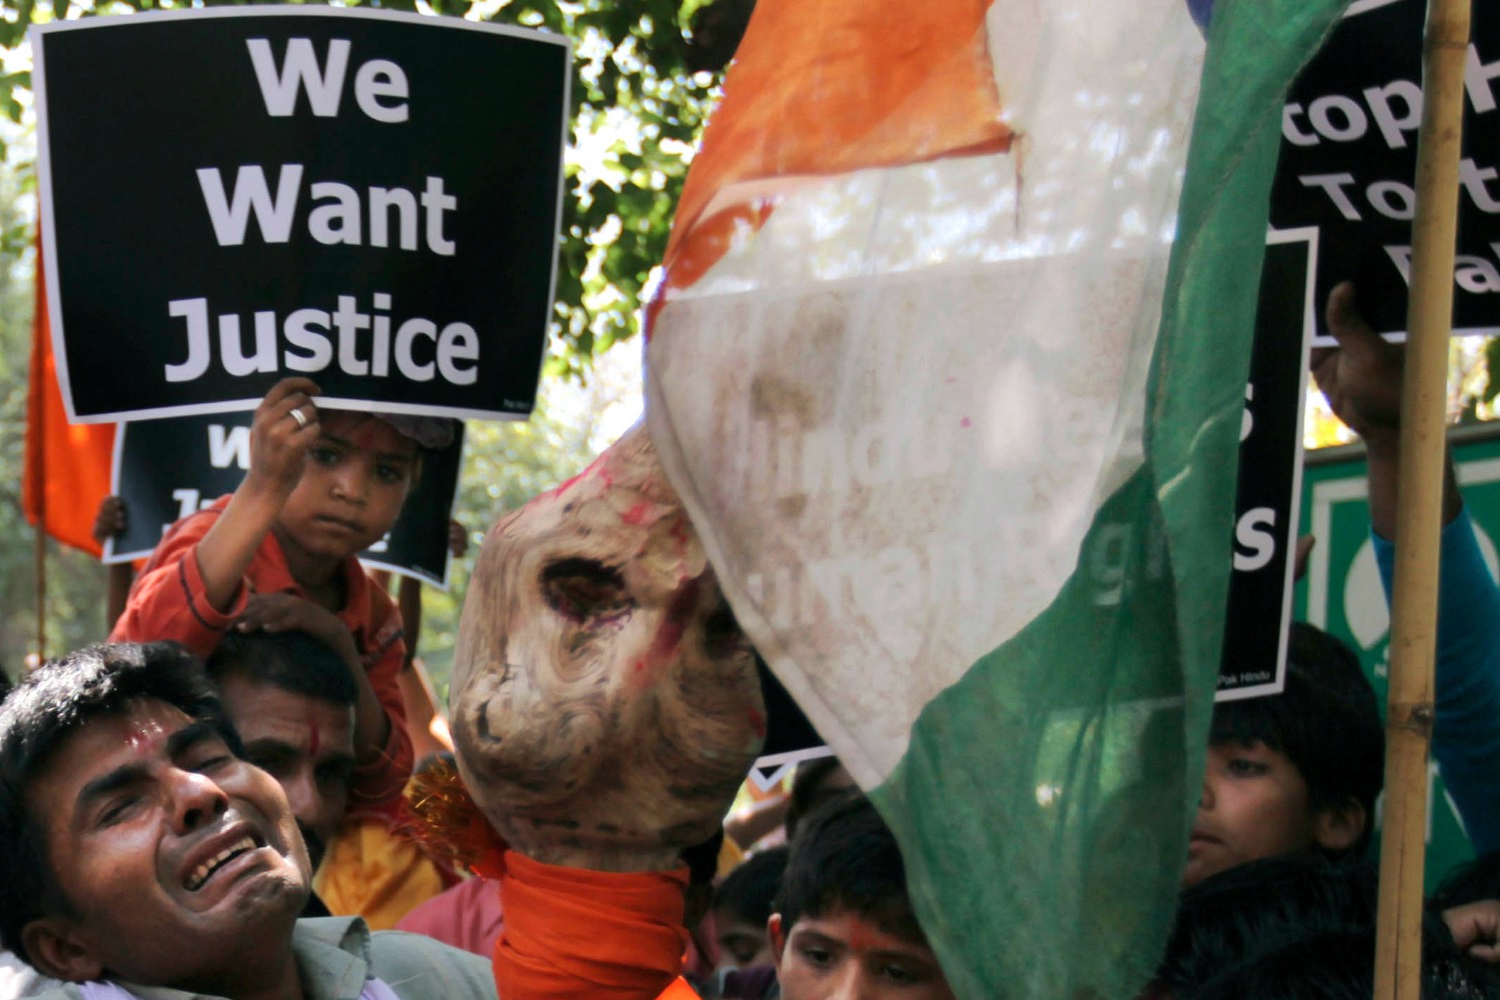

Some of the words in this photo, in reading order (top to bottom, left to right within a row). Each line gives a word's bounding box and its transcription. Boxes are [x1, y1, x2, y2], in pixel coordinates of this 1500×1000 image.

[246, 37, 410, 123] We
[196, 163, 457, 256] Want
[164, 292, 480, 386] Justice
